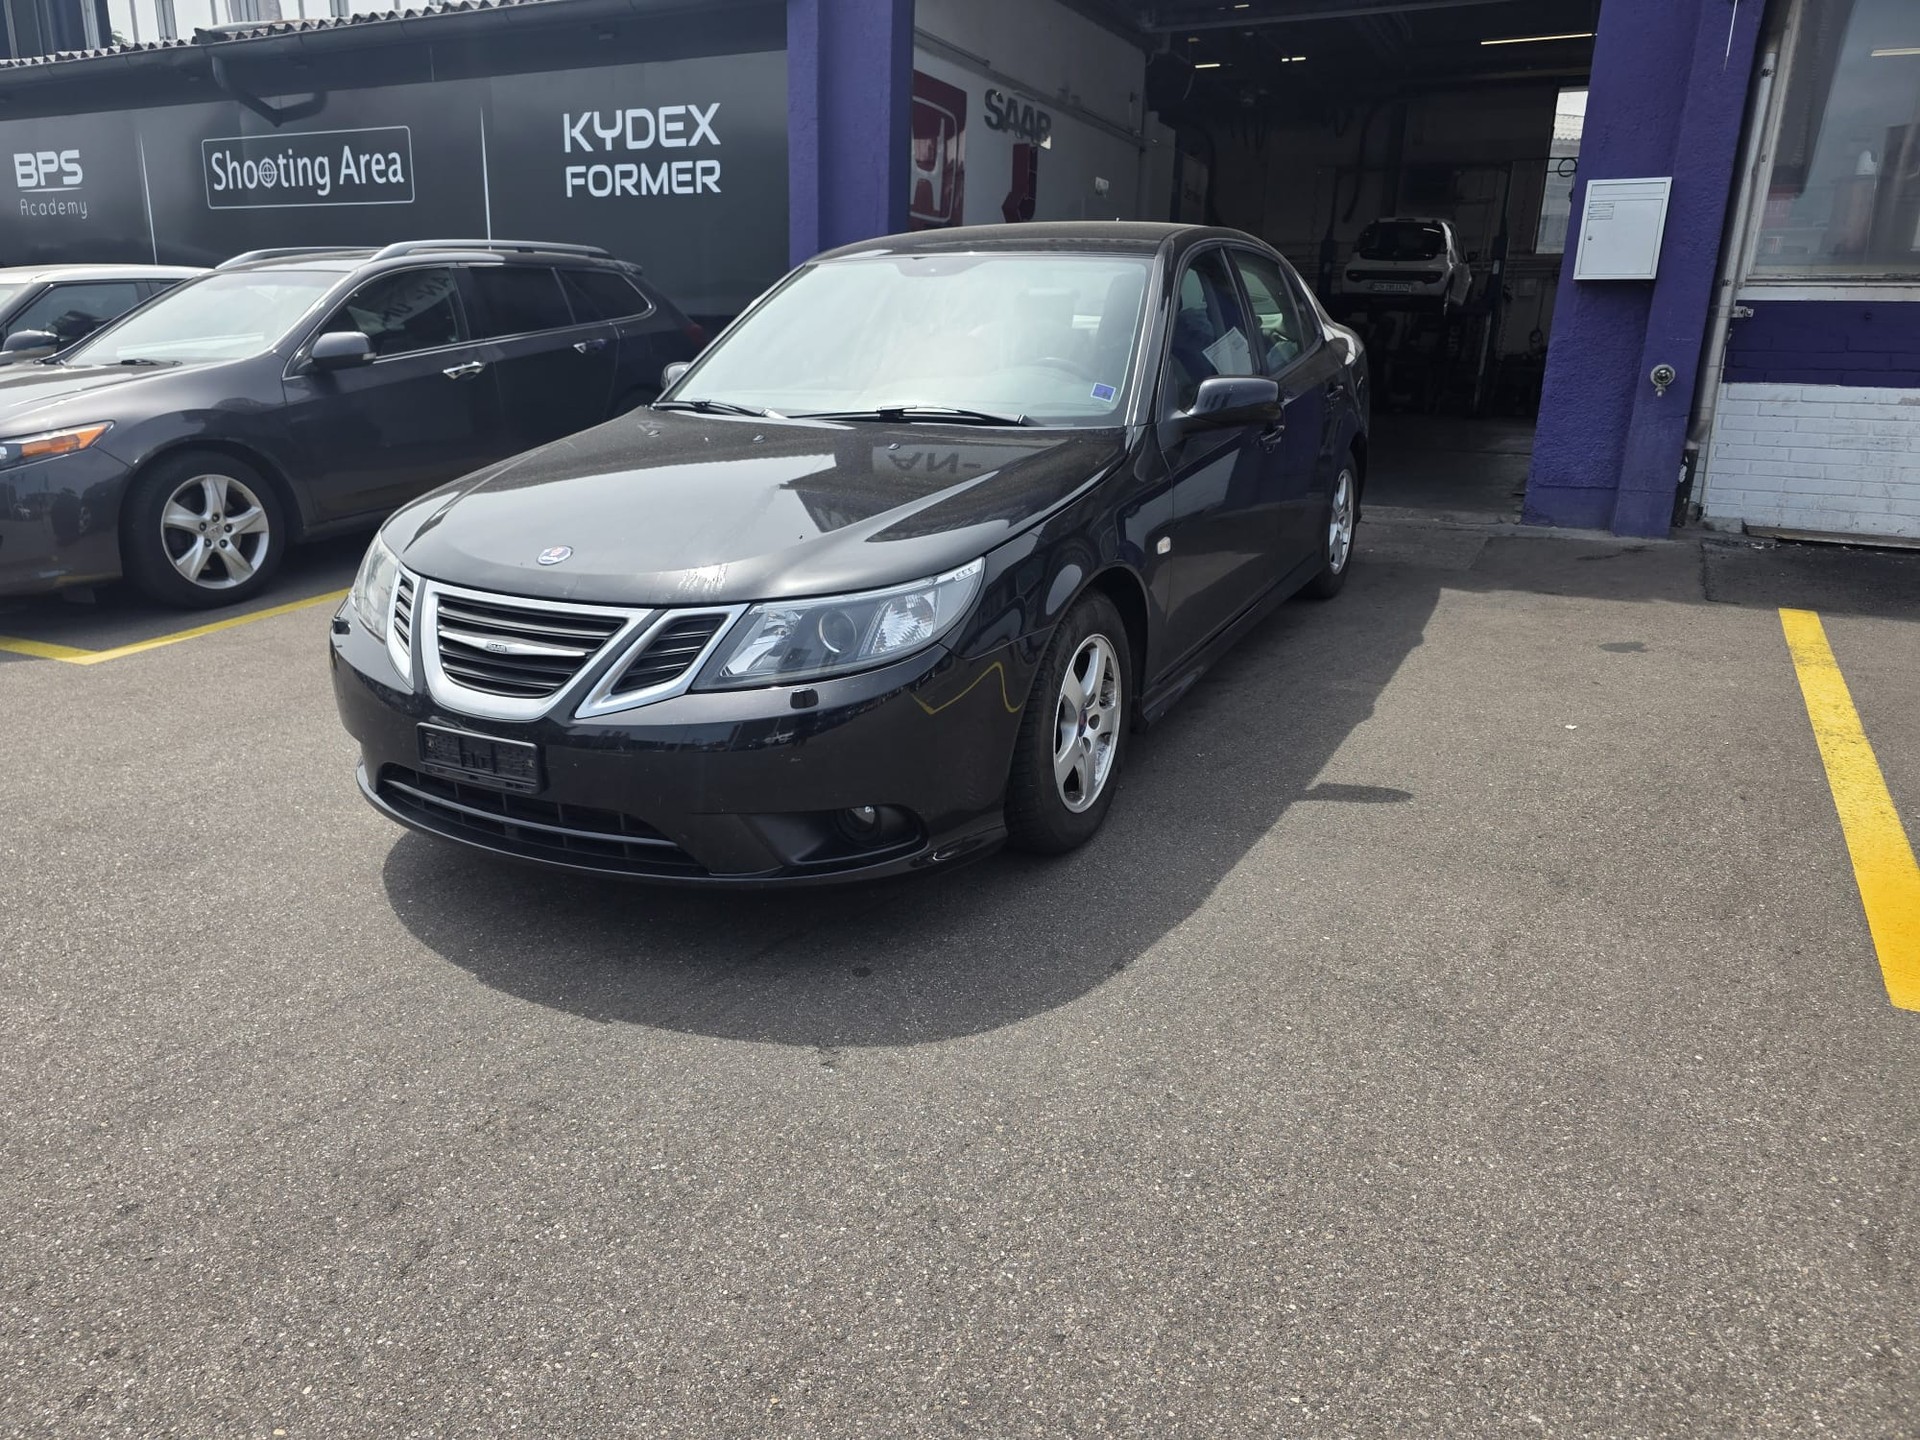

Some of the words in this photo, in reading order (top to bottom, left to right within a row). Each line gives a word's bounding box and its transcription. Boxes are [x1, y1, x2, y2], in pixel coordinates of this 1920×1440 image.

[563, 103, 721, 153] KYDEX
[13, 149, 83, 188] BPS
[211, 148, 331, 196] Shooting
[339, 145, 405, 185] Area
[566, 160, 721, 198] FORMER
[20, 197, 88, 220] Academy
